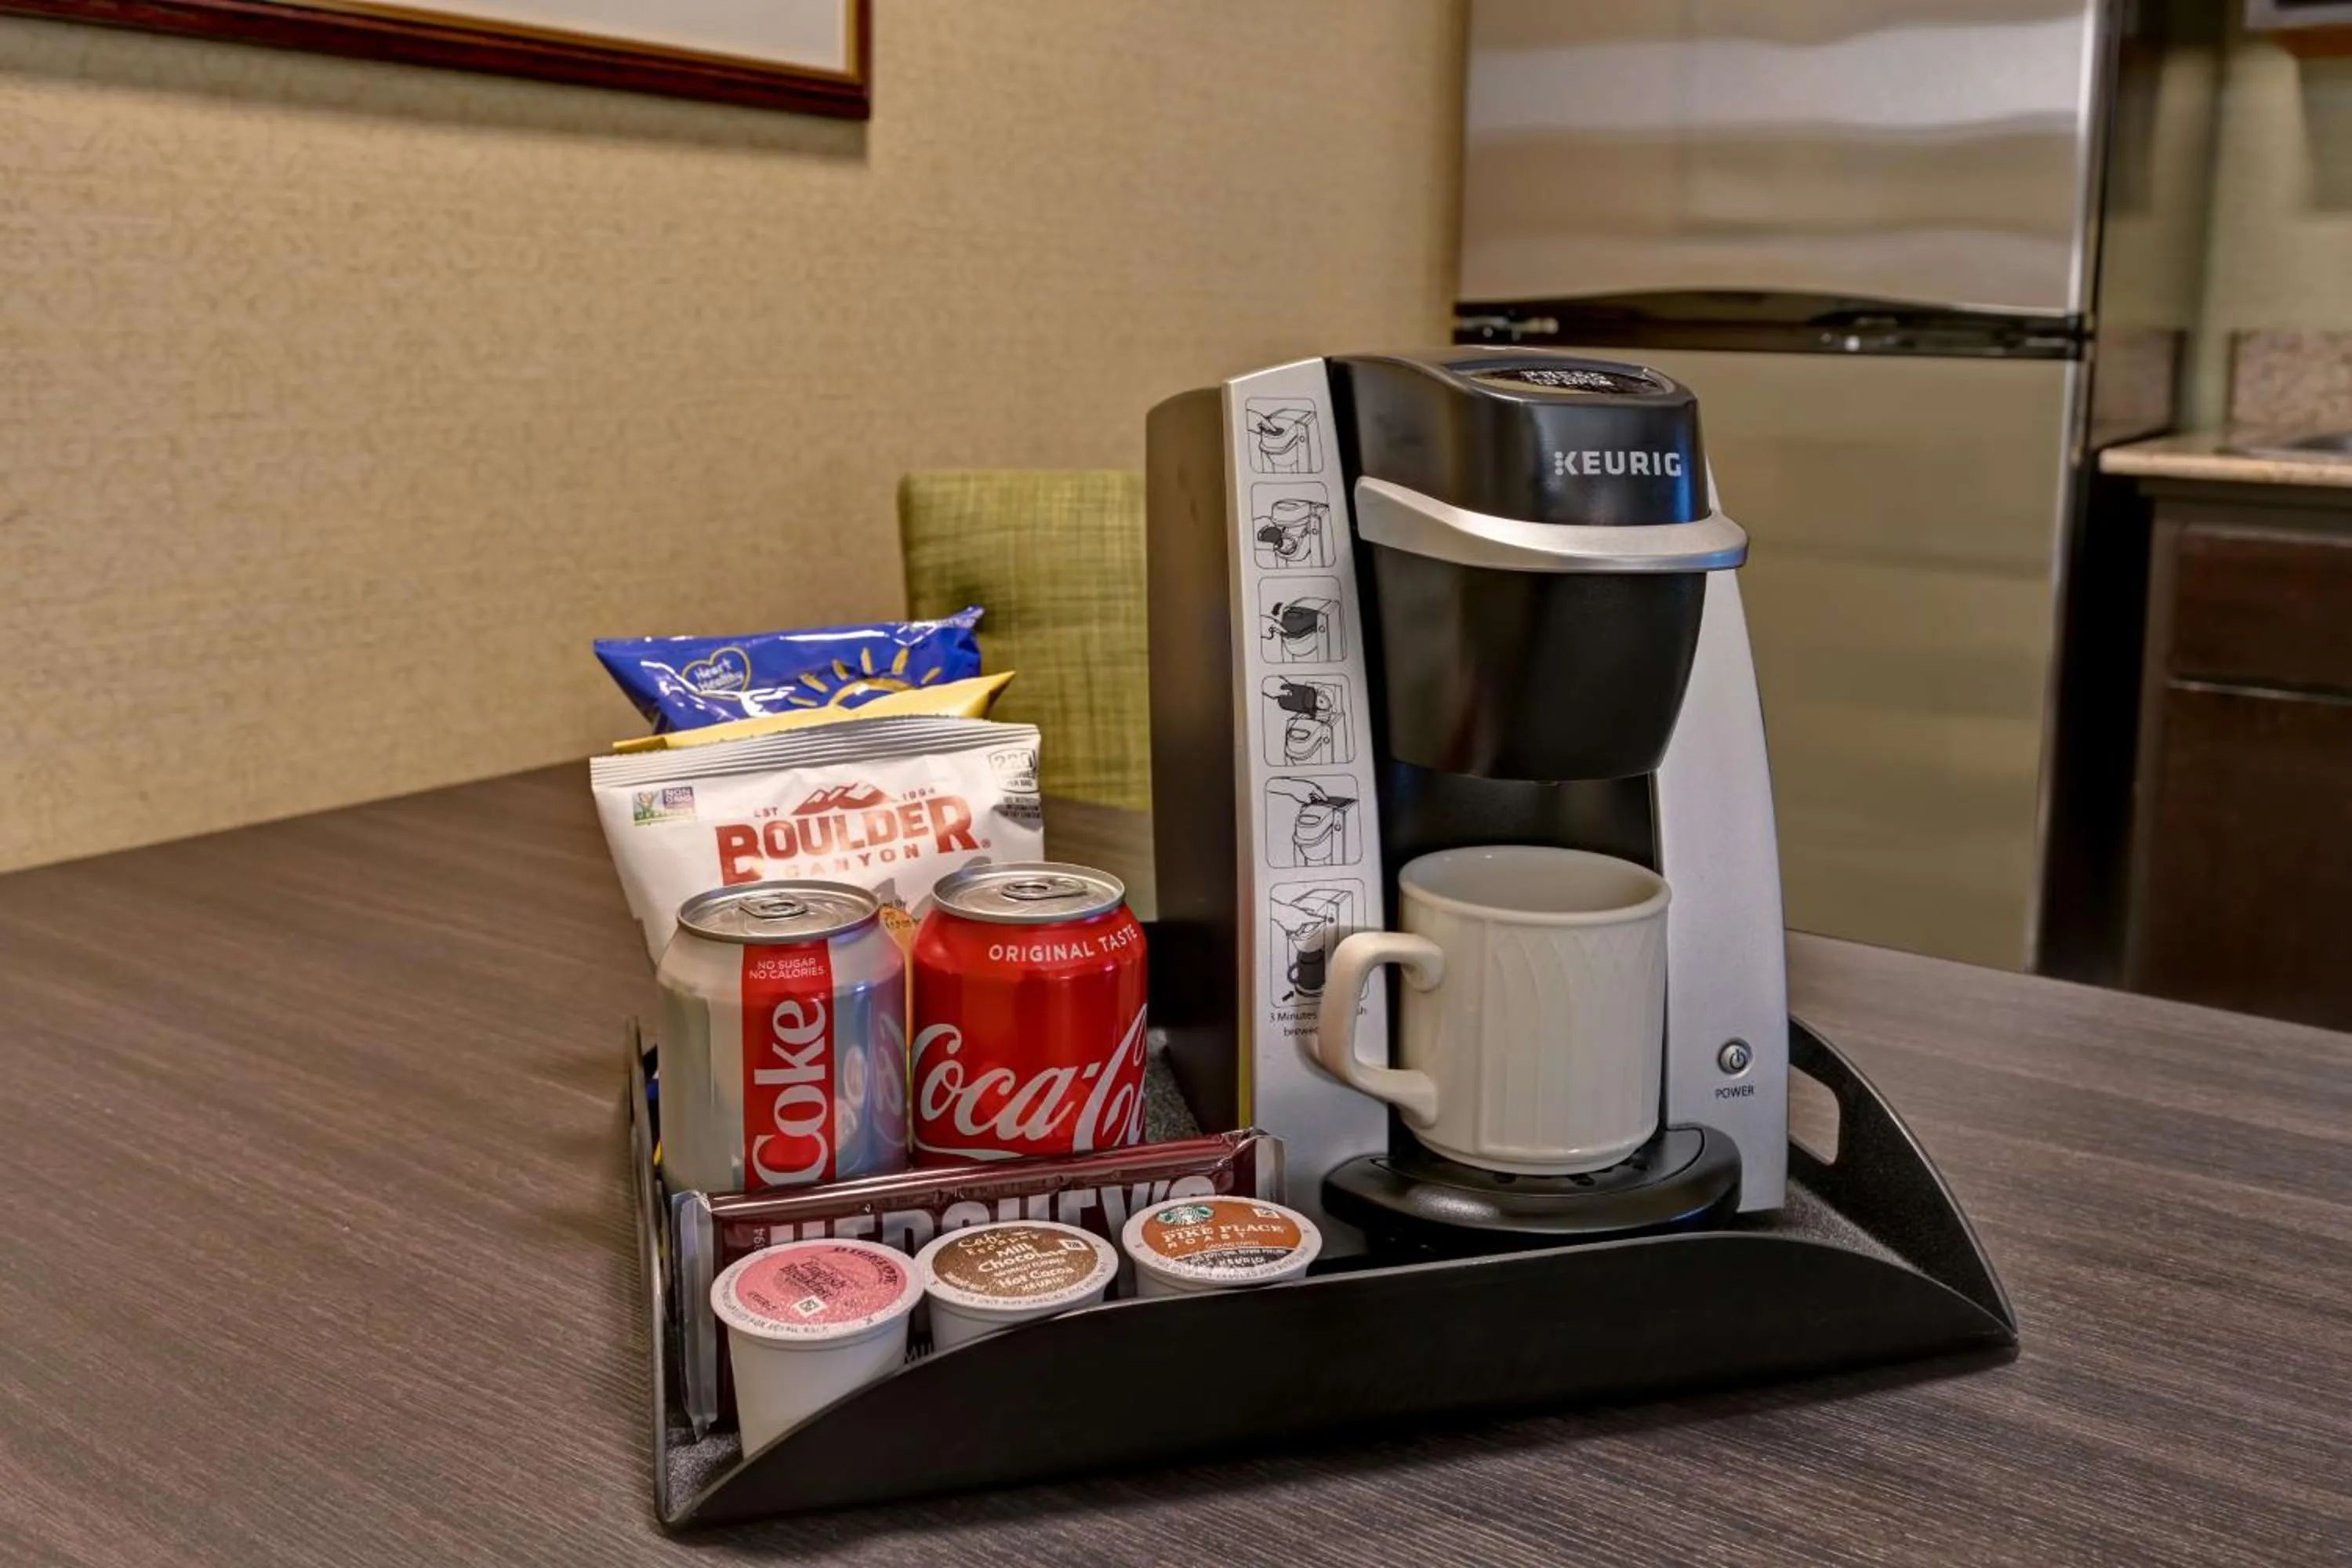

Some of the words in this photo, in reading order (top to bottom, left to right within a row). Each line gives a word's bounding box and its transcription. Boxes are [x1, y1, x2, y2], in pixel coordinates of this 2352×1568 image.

[1554, 451, 1682, 477] KEURIG
[715, 796, 979, 886] BOULDER
[784, 843, 920, 877] CANYON
[989, 941, 1095, 963] ORIGINAL
[1098, 923, 1138, 952] TASTE
[749, 970, 767, 979] NO
[768, 966, 825, 979] CALORIES
[757, 960, 775, 970] NO
[777, 957, 816, 970] SUGAR
[1276, 1011, 1318, 1021] Minutes
[752, 996, 829, 1186] Coke
[1715, 1084, 1755, 1099] POWER
[1162, 1226, 1214, 1243] PIKE
[1218, 1222, 1283, 1234] PLACE
[1167, 1232, 1249, 1249] ROAST
[978, 1248, 1069, 1272] Chocolate
[996, 1242, 1034, 1258] Milk
[997, 1270, 1028, 1288] Hot
[1029, 1266, 1075, 1280] Cocoa
